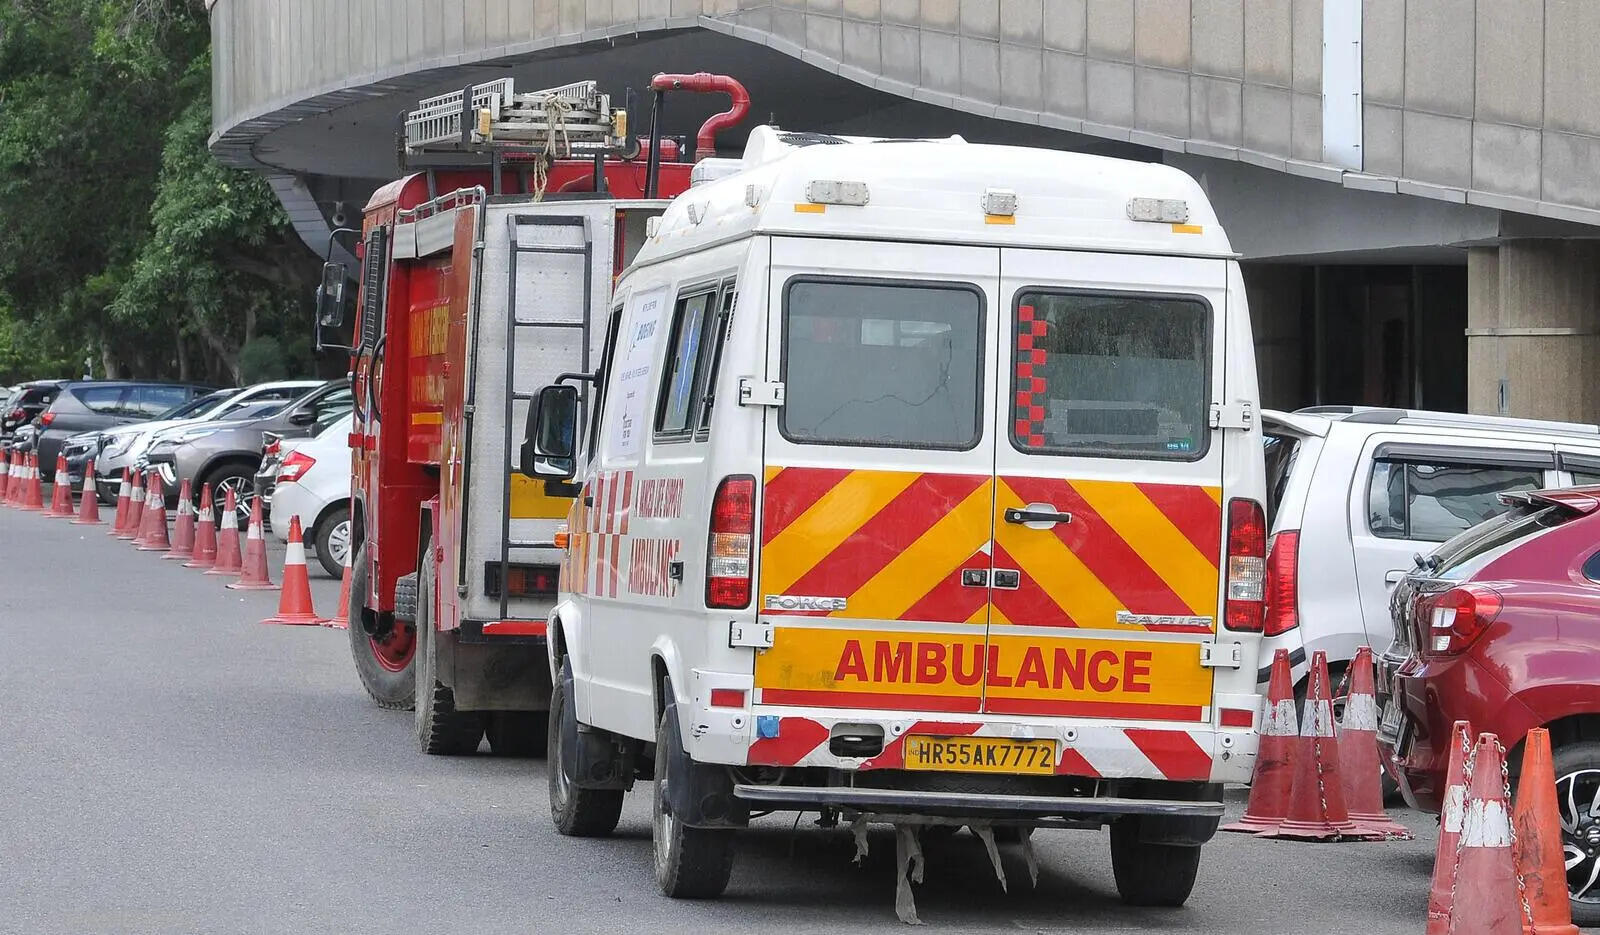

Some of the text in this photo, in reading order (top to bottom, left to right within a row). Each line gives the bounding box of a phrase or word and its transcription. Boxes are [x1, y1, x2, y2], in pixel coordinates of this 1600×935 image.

[765, 595, 847, 610] FORCE
[834, 639, 1152, 693] AMBULANCE
[919, 742, 1051, 768] HR55AK7772
